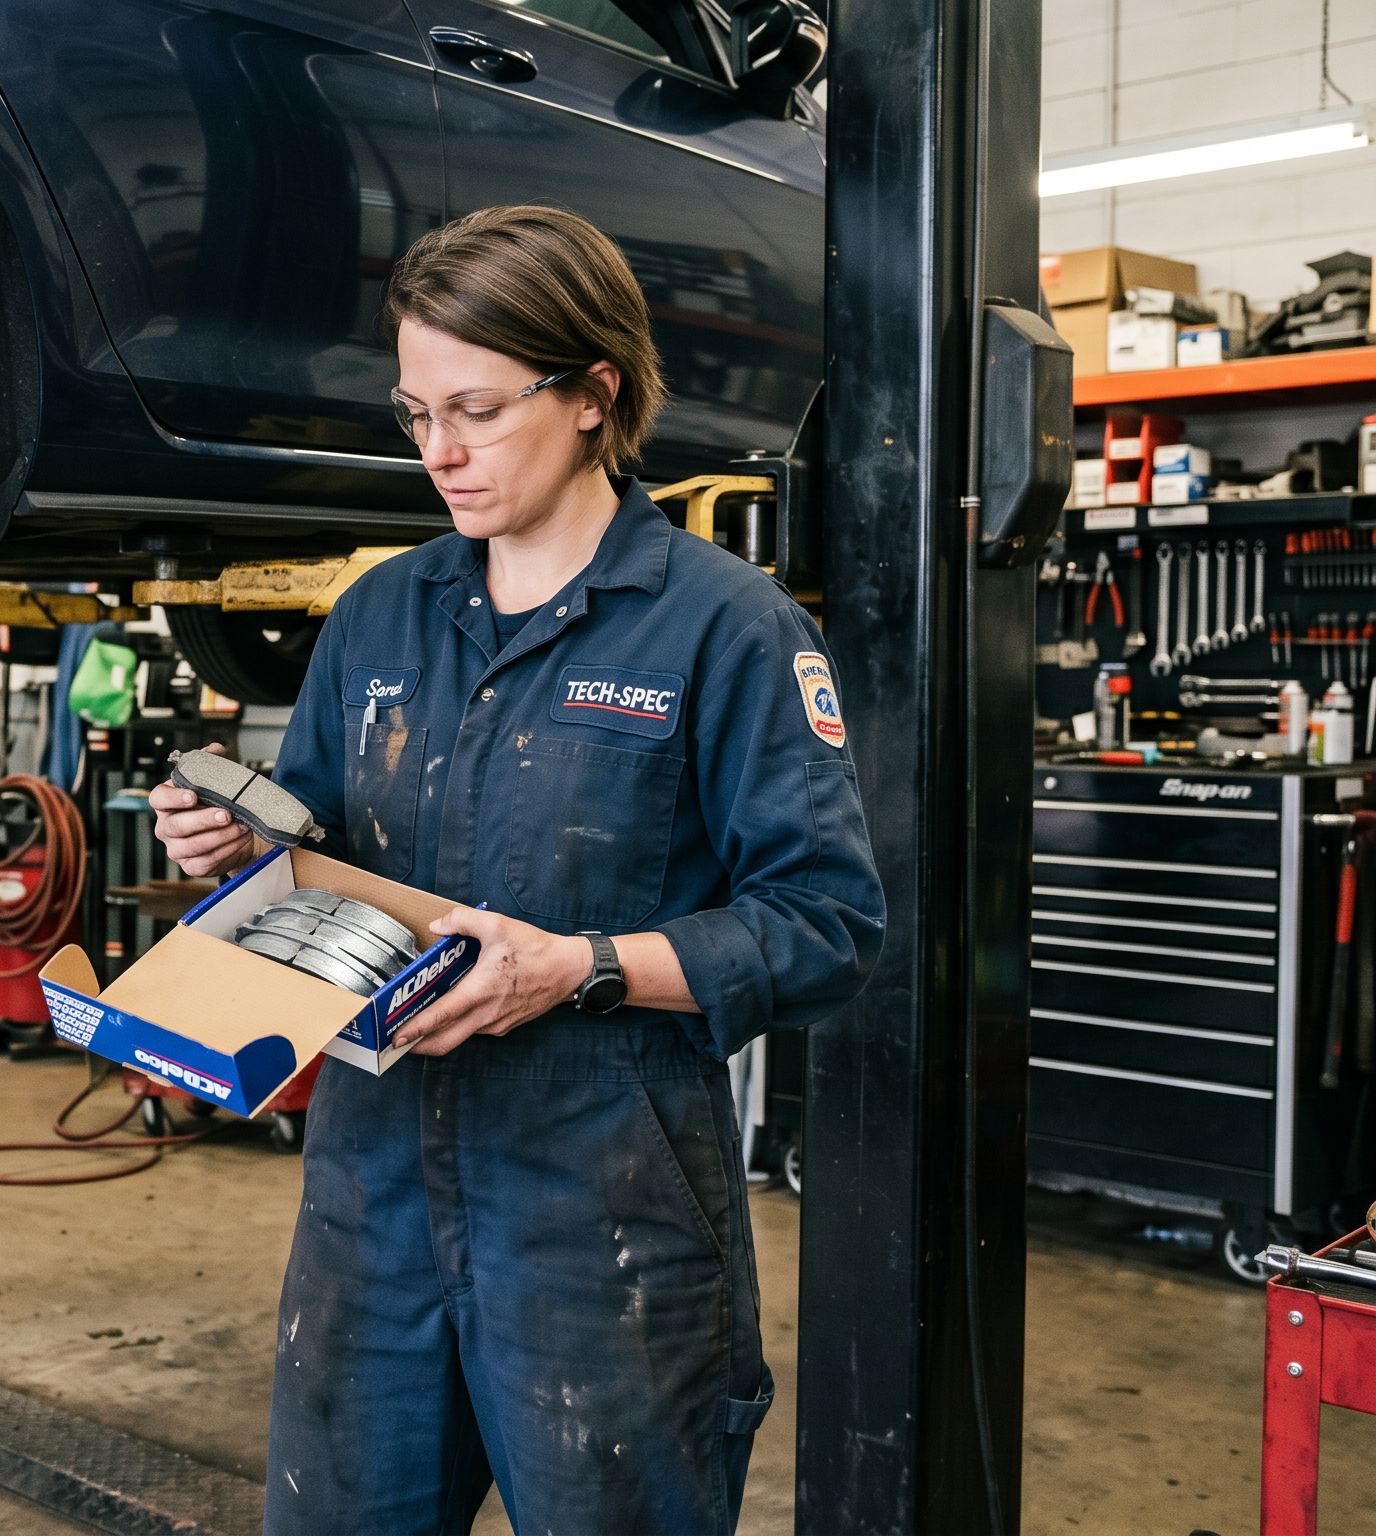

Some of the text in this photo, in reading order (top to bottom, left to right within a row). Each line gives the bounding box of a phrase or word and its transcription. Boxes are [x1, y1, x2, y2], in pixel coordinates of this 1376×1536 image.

[1159, 778, 1252, 801] Snap-on
[387, 940, 466, 1016] ACDelco
[135, 1049, 231, 1100] ACDelco
